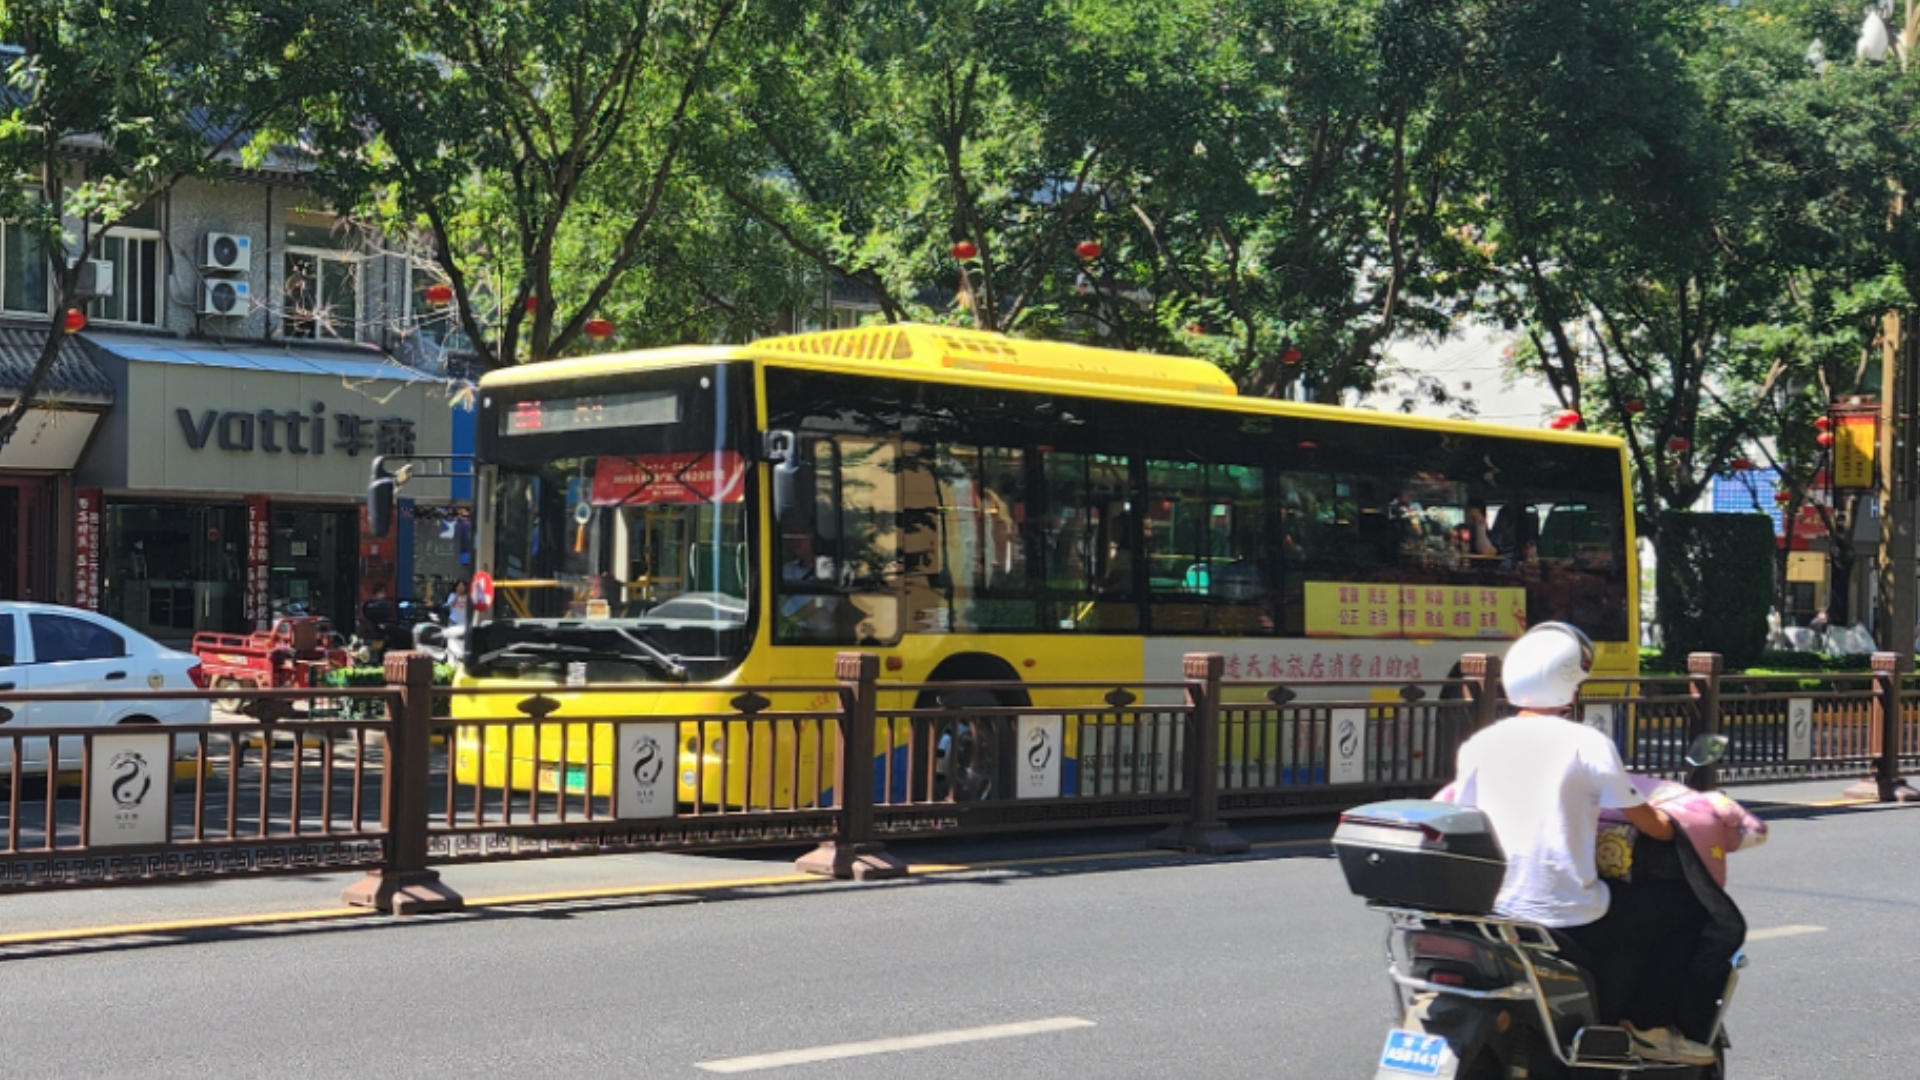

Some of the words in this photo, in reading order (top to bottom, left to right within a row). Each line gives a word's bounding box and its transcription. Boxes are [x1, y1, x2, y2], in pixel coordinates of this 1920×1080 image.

[176, 400, 325, 455] vatti
[333, 412, 416, 457] 华帝
[1368, 587, 1388, 605] 民主
[1339, 609, 1359, 626] 公正
[1368, 609, 1388, 626] 法治
